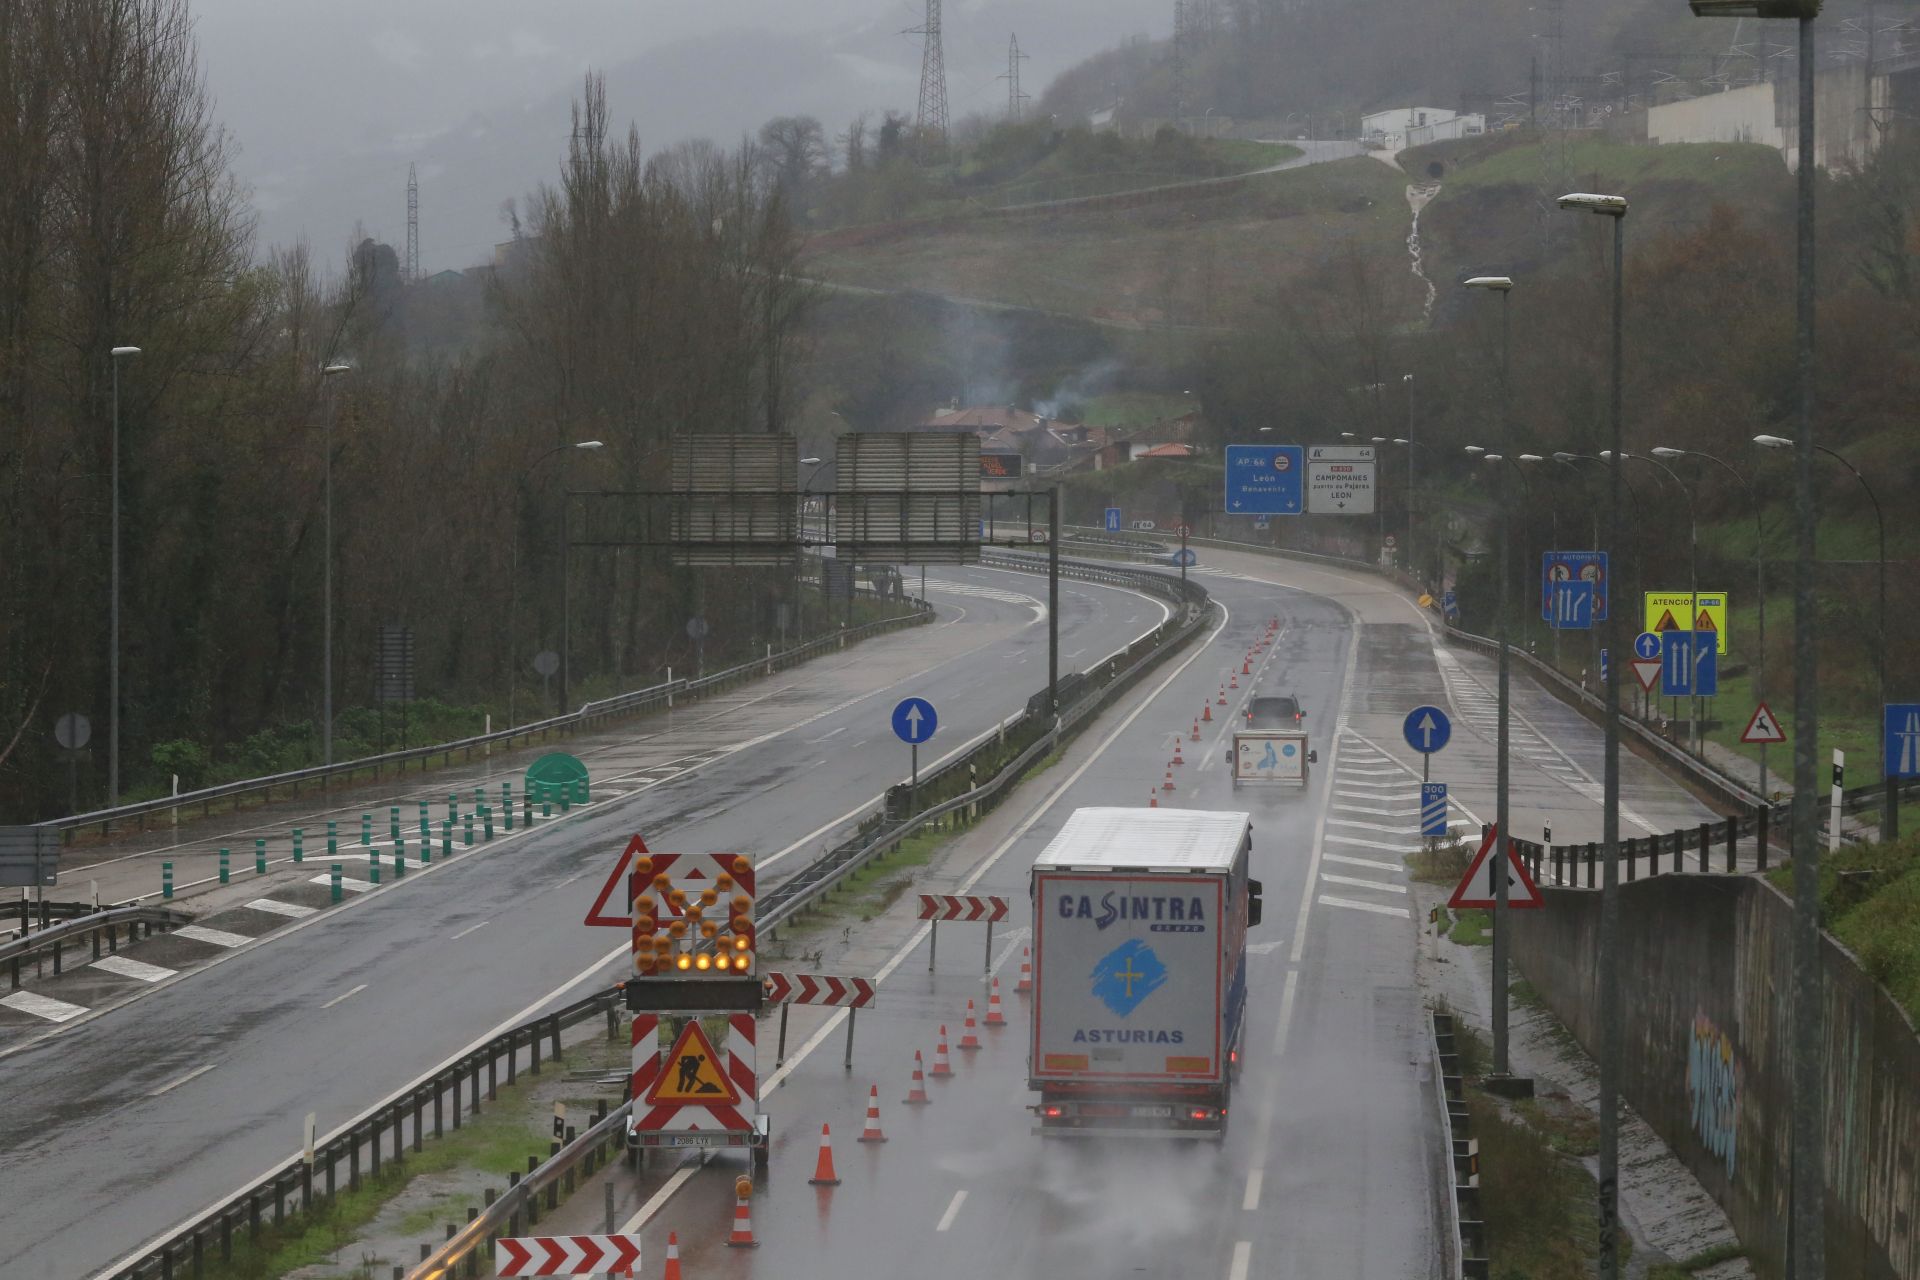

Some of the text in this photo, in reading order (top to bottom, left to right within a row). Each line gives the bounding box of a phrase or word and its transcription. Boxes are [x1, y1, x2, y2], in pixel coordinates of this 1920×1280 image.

[1359, 449, 1370, 457] 64
[1424, 785, 1444, 793] 300
[1059, 891, 1205, 930] CASINTRA
[1073, 1029, 1184, 1044] ASTURIAS
